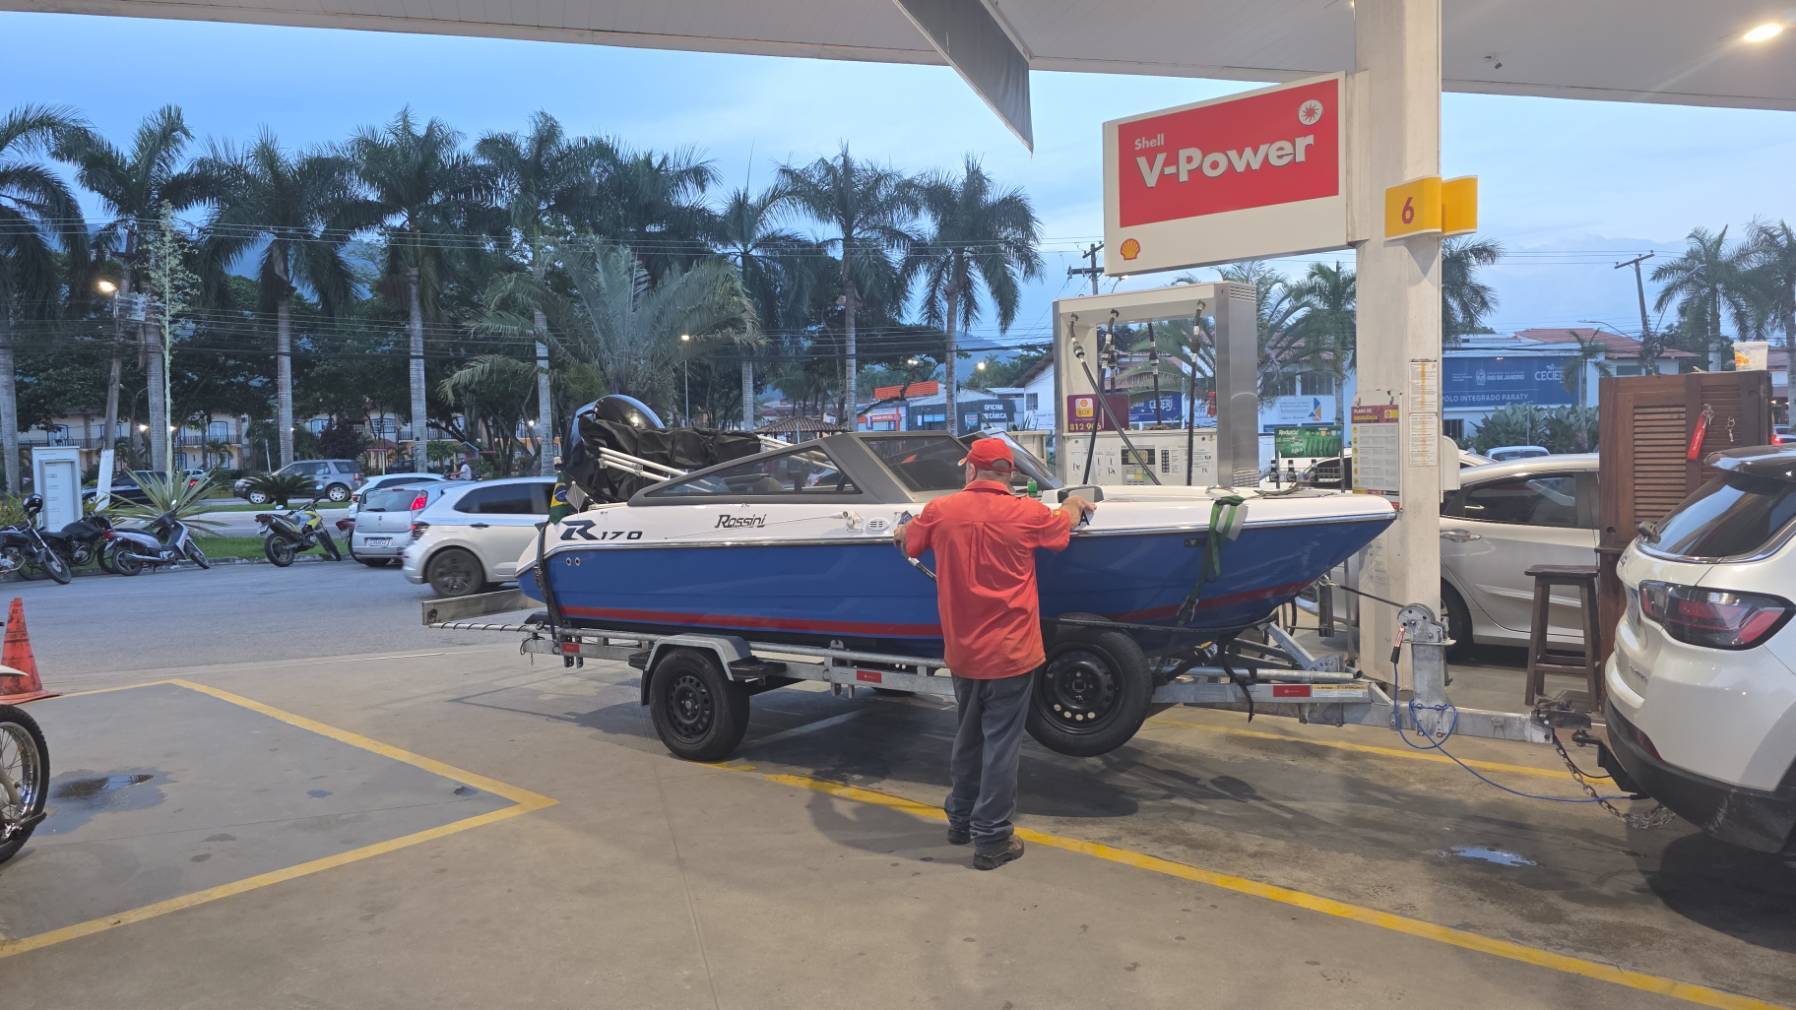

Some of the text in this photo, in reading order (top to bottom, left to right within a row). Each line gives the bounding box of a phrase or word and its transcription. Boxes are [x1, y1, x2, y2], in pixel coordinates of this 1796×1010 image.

[1135, 133, 1165, 151] Shell
[1136, 134, 1315, 188] V-Power
[1401, 197, 1415, 225] 6
[1534, 370, 1563, 382] CECIE
[1444, 393, 1529, 403] OLO INTEGRADO PARATY
[715, 513, 766, 529] Rossini
